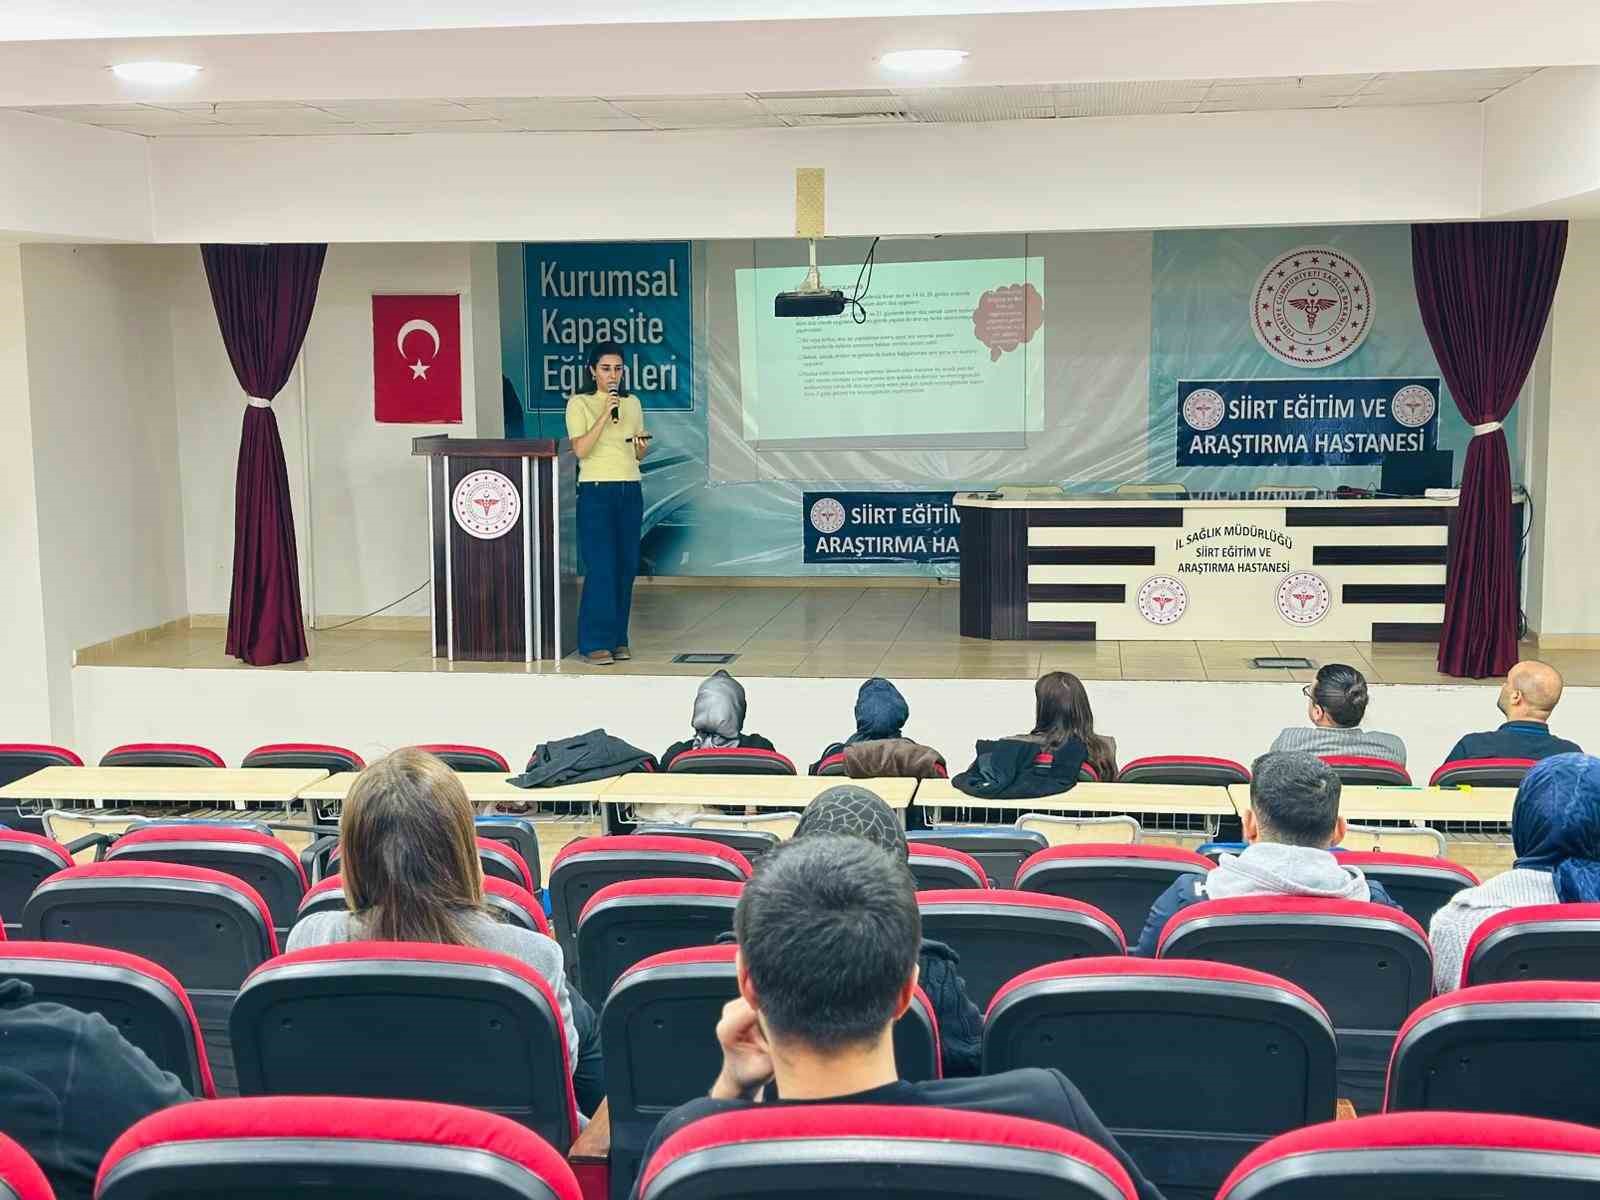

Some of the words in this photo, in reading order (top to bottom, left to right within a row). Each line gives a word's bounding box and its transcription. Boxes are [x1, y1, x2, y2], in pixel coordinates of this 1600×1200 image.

[540, 258, 678, 297] Kurumsal
[542, 308, 664, 352] Kapasite
[543, 353, 678, 399] Eğileri
[1228, 394, 1278, 419] SİİRT
[1283, 393, 1354, 419] EĞİTİM
[1360, 398, 1386, 418] VE
[1189, 434, 1309, 458] ARAŞTIRMA
[1315, 428, 1425, 453] HASTANESİ
[851, 503, 897, 525] SİİRT
[815, 536, 927, 557] ARAŞTIRMA
[1186, 526, 1221, 545] SAĞLIK
[1223, 523, 1292, 550] MÜDÜRLÜĞÜ
[1196, 545, 1219, 558] SİİRT
[1222, 544, 1256, 557] EĞİTİM
[1259, 547, 1272, 557] VE
[1178, 562, 1235, 575] ARAŞTIRMA
[1237, 560, 1290, 573] HASTANESİ
